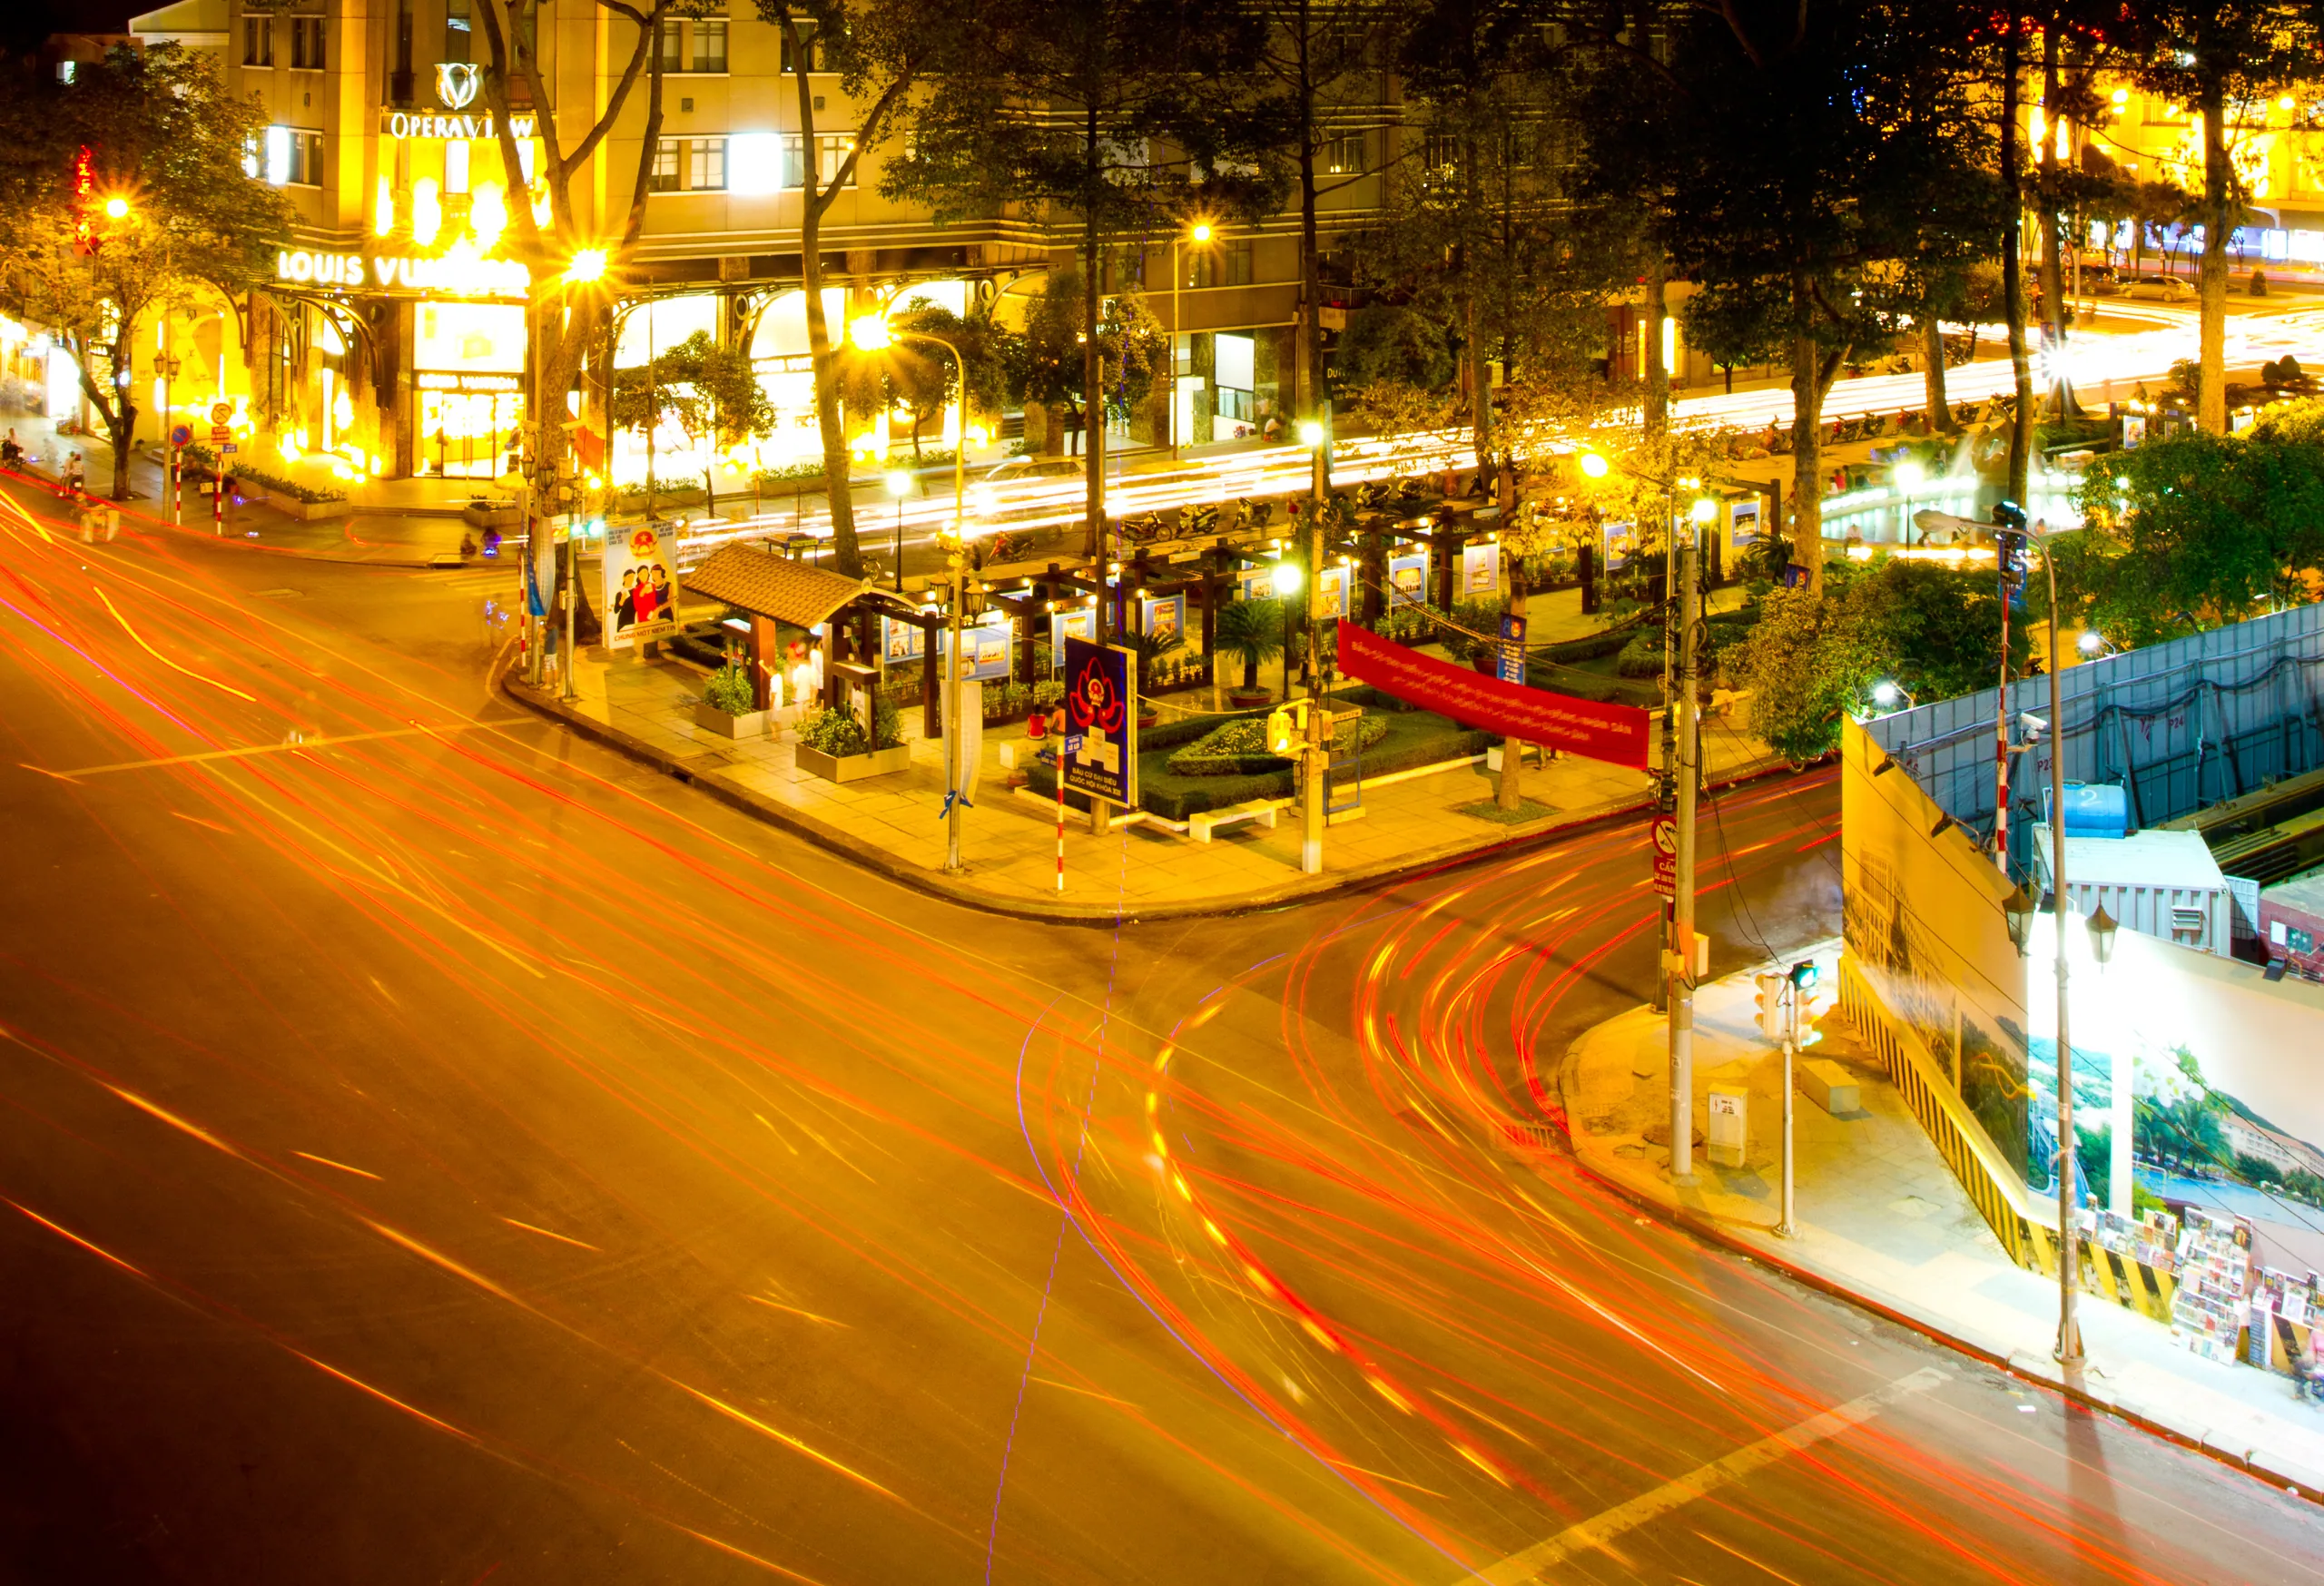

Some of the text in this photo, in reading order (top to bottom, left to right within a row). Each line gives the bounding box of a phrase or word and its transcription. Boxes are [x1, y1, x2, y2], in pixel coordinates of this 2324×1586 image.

[390, 112, 534, 141] OPERAVIW
[279, 251, 364, 285] LOUIS
[2080, 789, 2103, 808] 2
